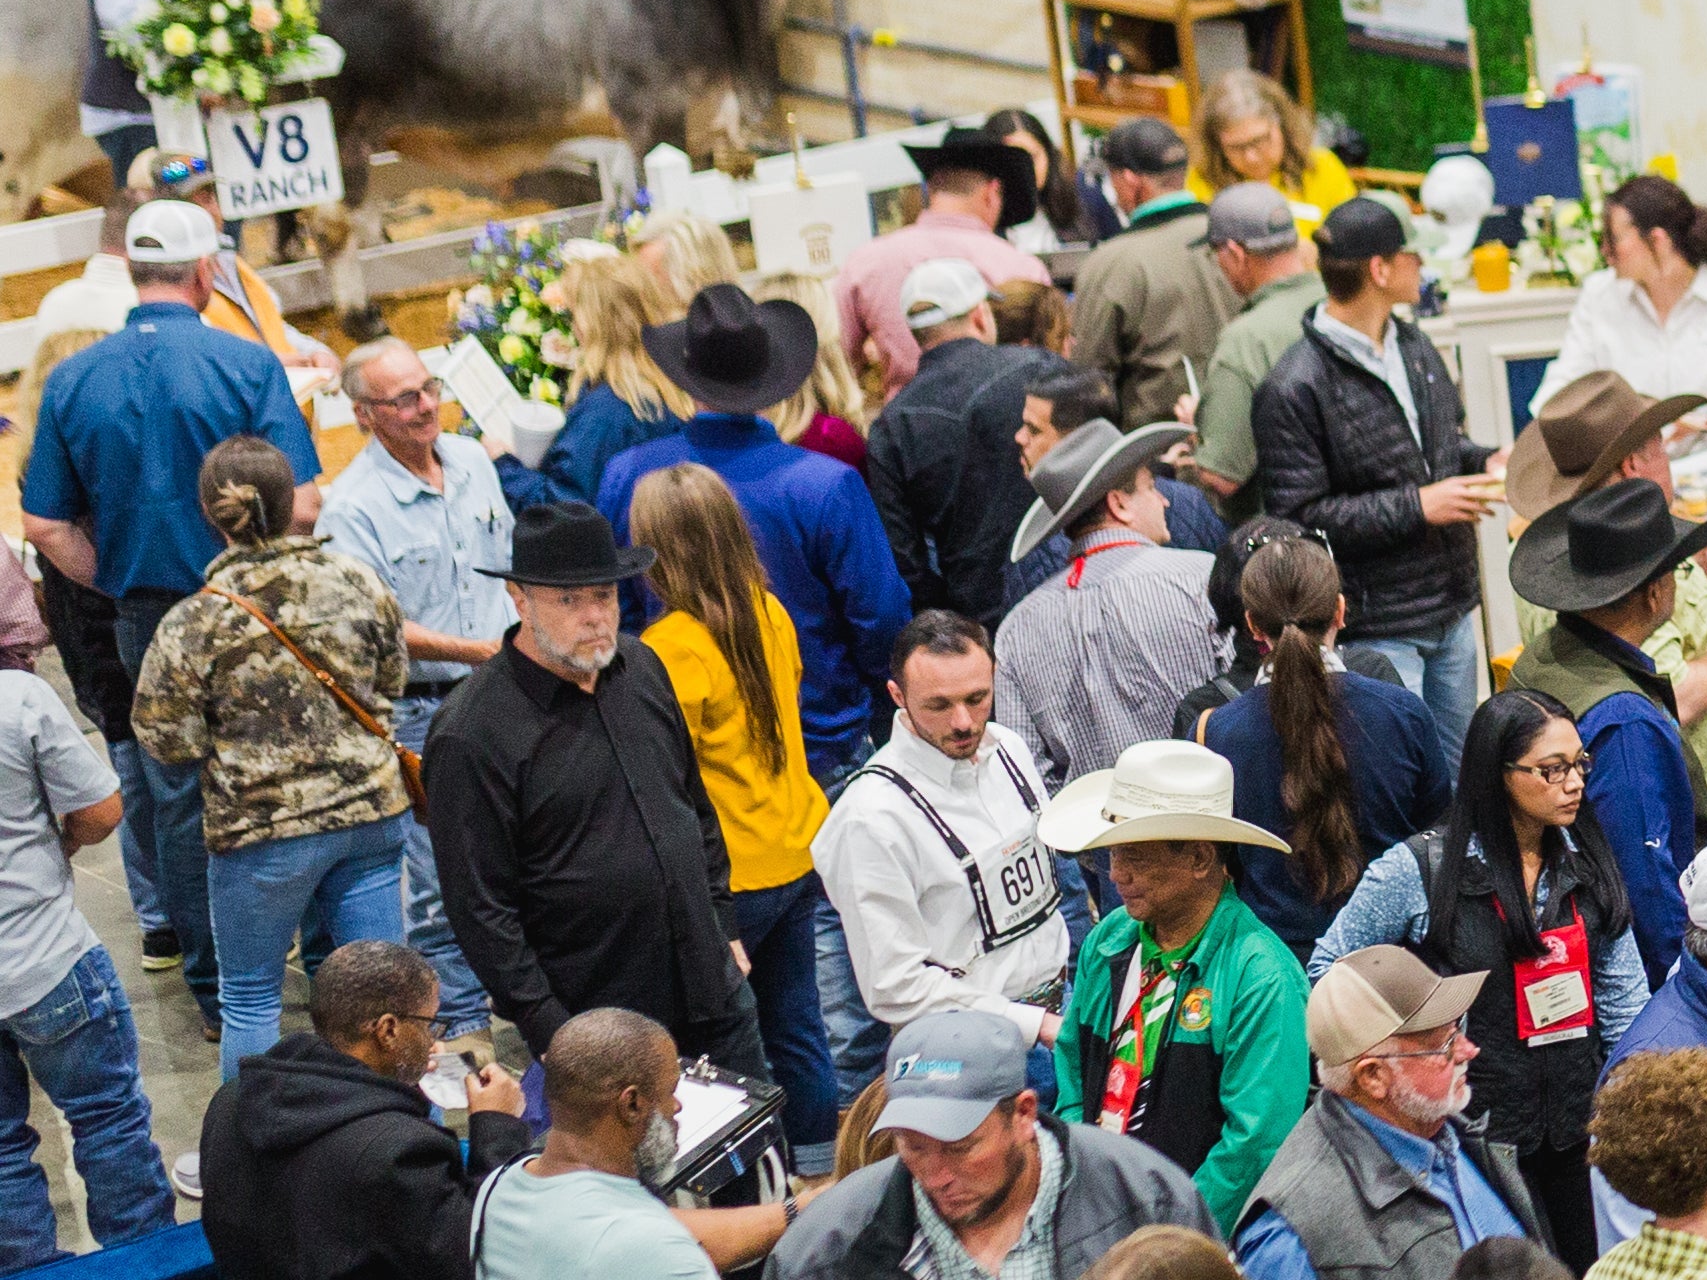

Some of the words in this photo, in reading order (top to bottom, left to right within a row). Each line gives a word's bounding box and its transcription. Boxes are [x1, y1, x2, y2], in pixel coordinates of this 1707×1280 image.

[233, 114, 309, 169] V8
[230, 167, 328, 207] RANCH
[1000, 847, 1045, 906] 691
